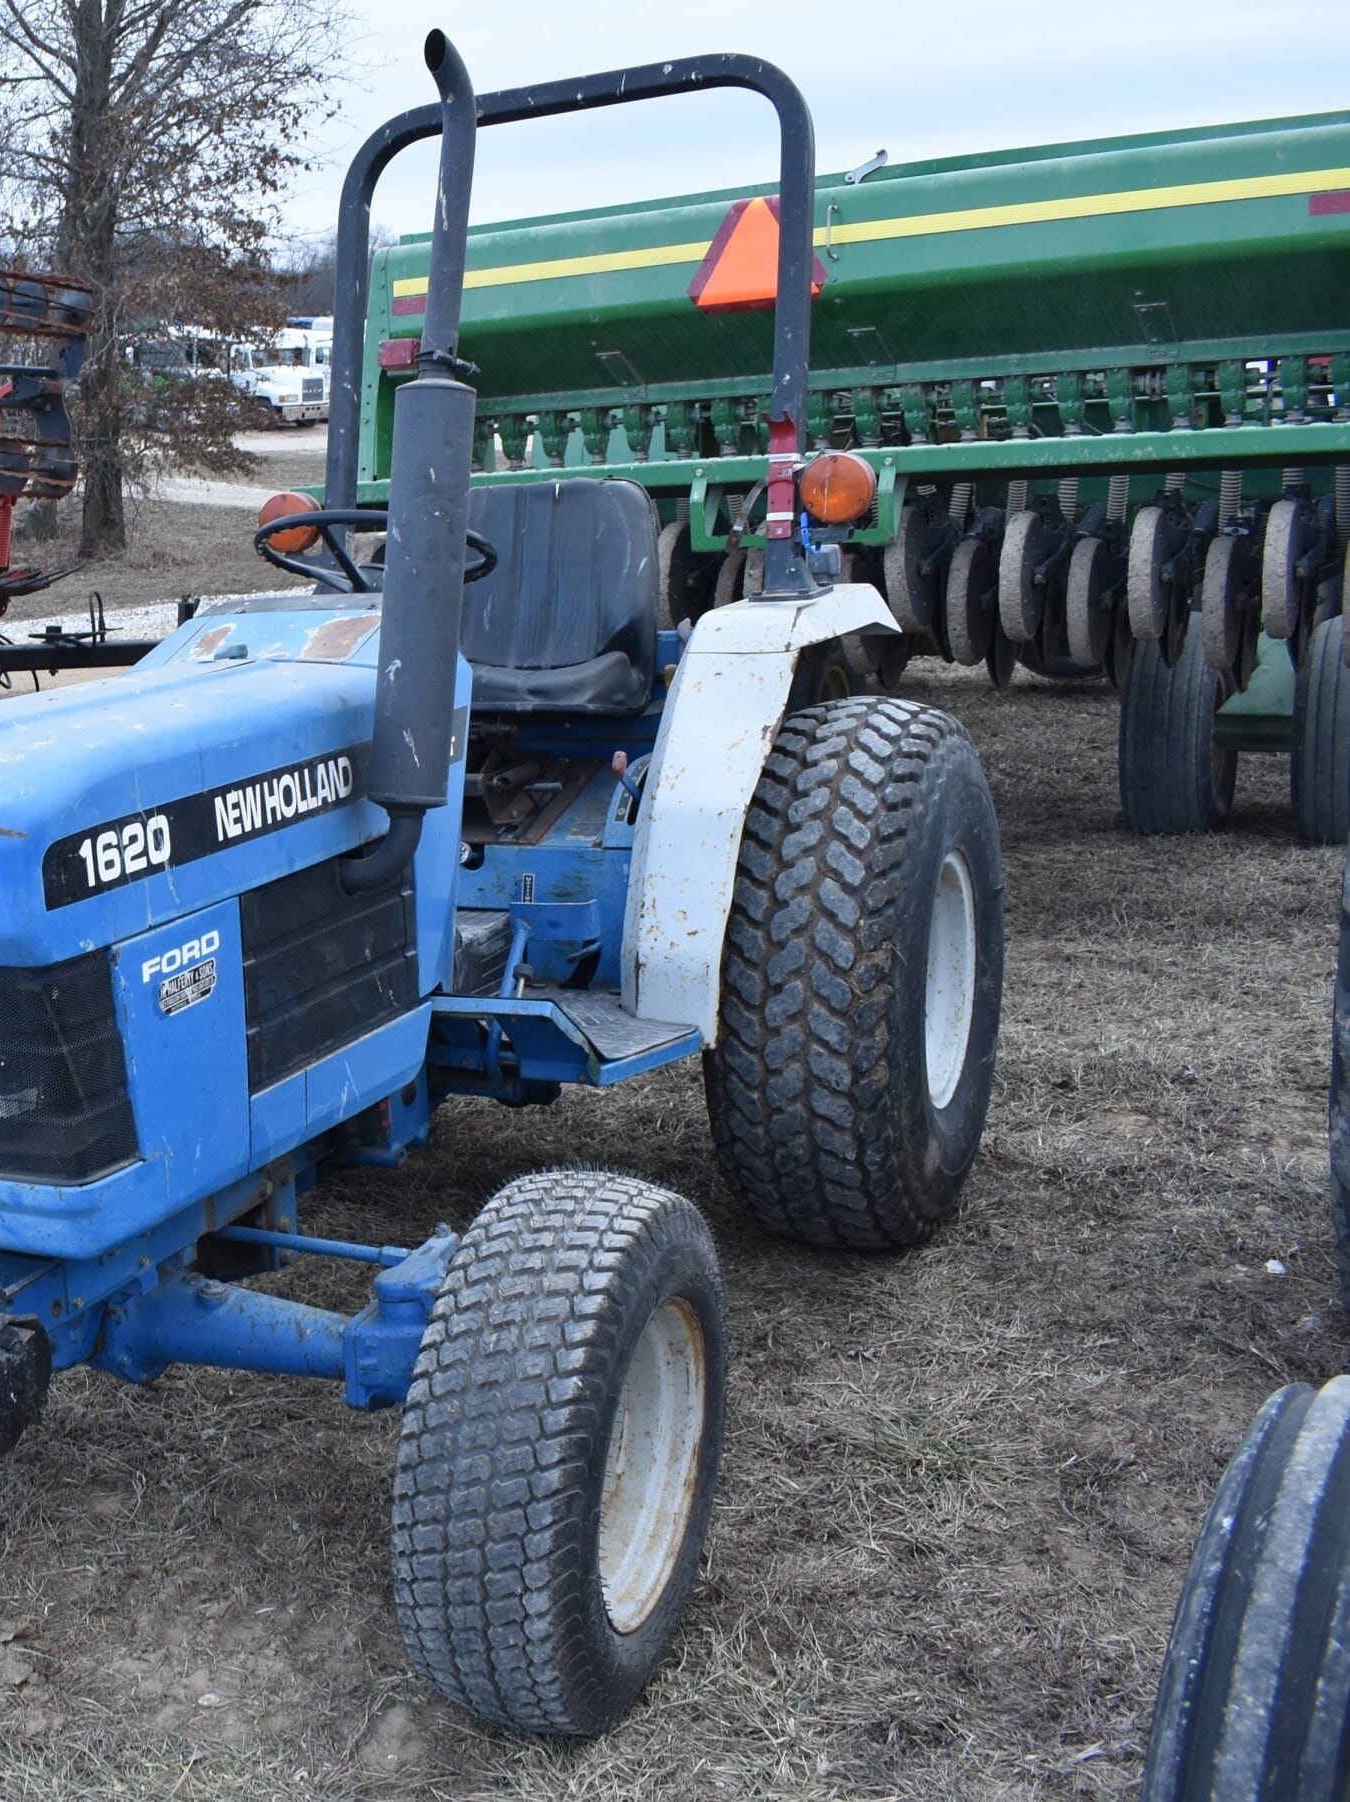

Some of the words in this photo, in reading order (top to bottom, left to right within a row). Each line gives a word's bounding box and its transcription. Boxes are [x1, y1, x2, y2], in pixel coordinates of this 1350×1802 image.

[78, 814, 171, 887] 1620
[214, 783, 262, 841] NEW
[263, 756, 353, 824] HOLLAND
[142, 930, 219, 984] FORD
